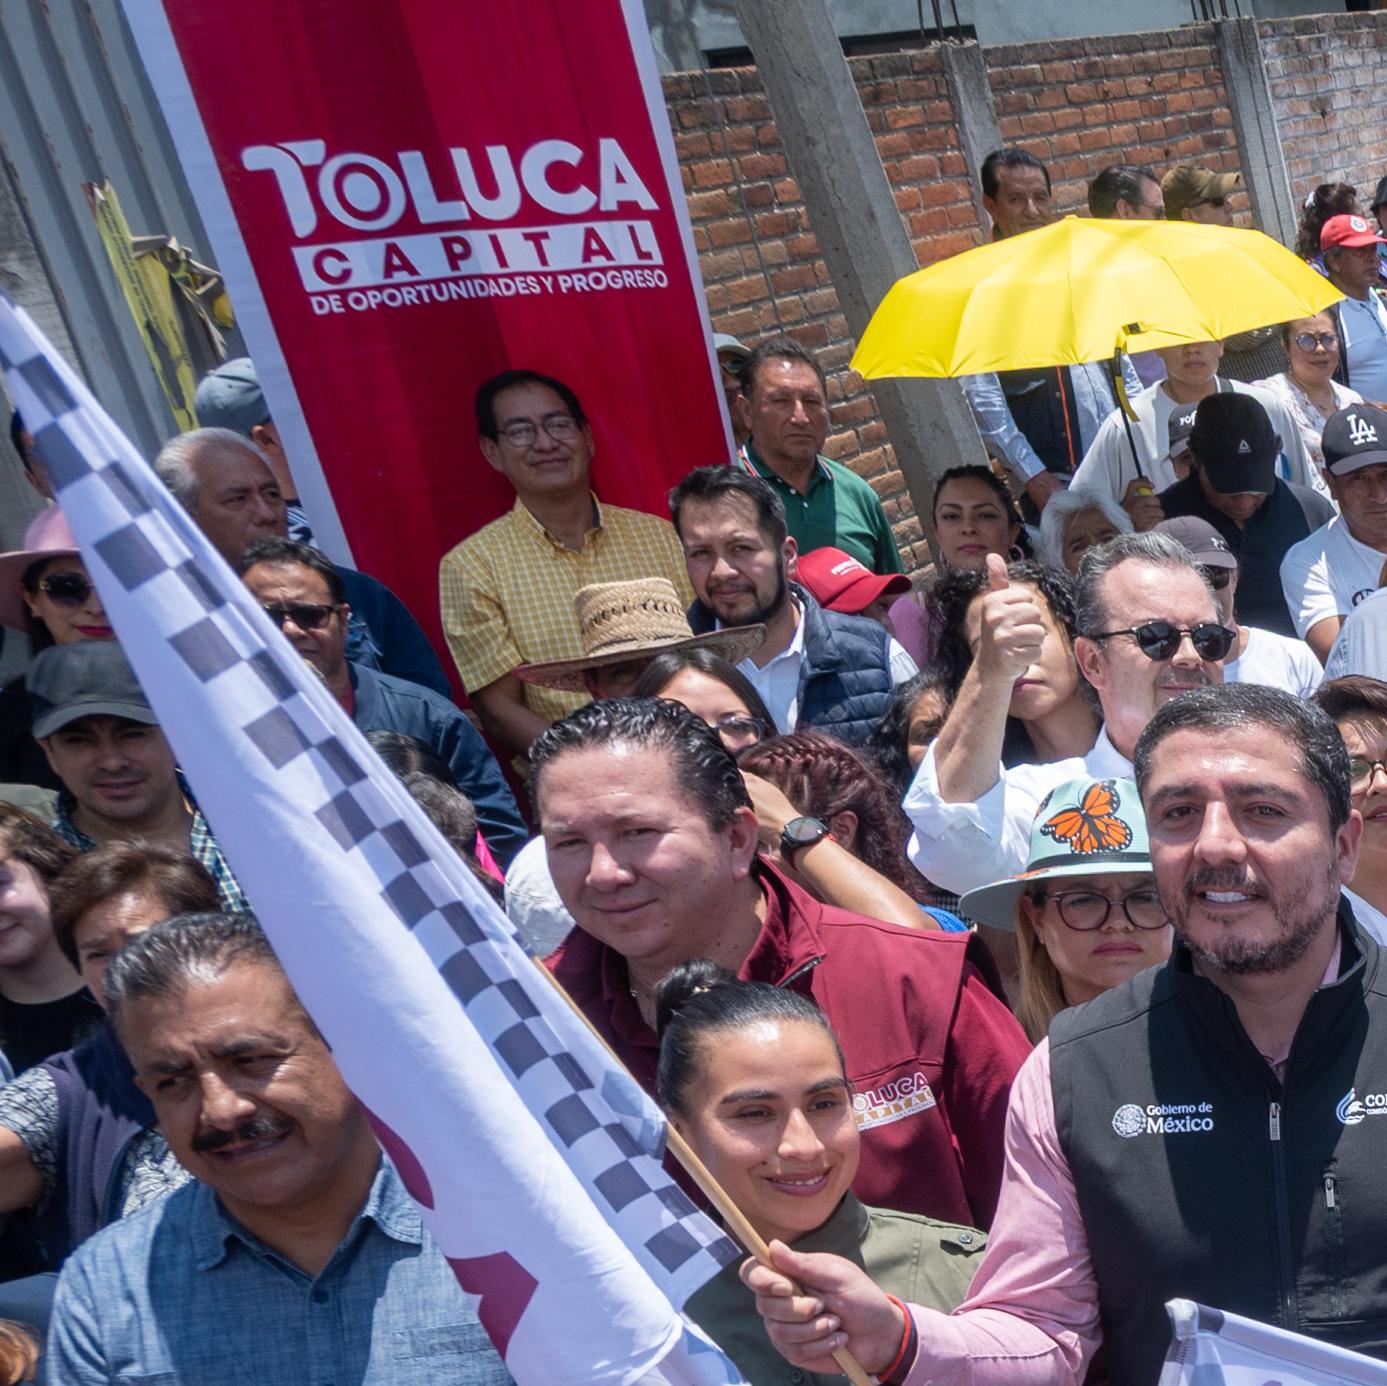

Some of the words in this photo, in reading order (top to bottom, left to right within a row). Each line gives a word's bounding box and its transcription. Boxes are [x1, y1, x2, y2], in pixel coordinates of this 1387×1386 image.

[241, 138, 660, 239] TOLUCA
[312, 224, 653, 286] CAPITAL
[310, 292, 345, 316] DE
[347, 277, 541, 313] OPORTUNIDADES
[539, 275, 555, 294] Y
[559, 268, 670, 294] PROGRESO
[1347, 414, 1378, 446] LA
[853, 1071, 929, 1112] OLUCA
[1146, 1103, 1197, 1116] Gobierno
[1198, 1101, 1213, 1113] de
[1146, 1115, 1214, 1134] México
